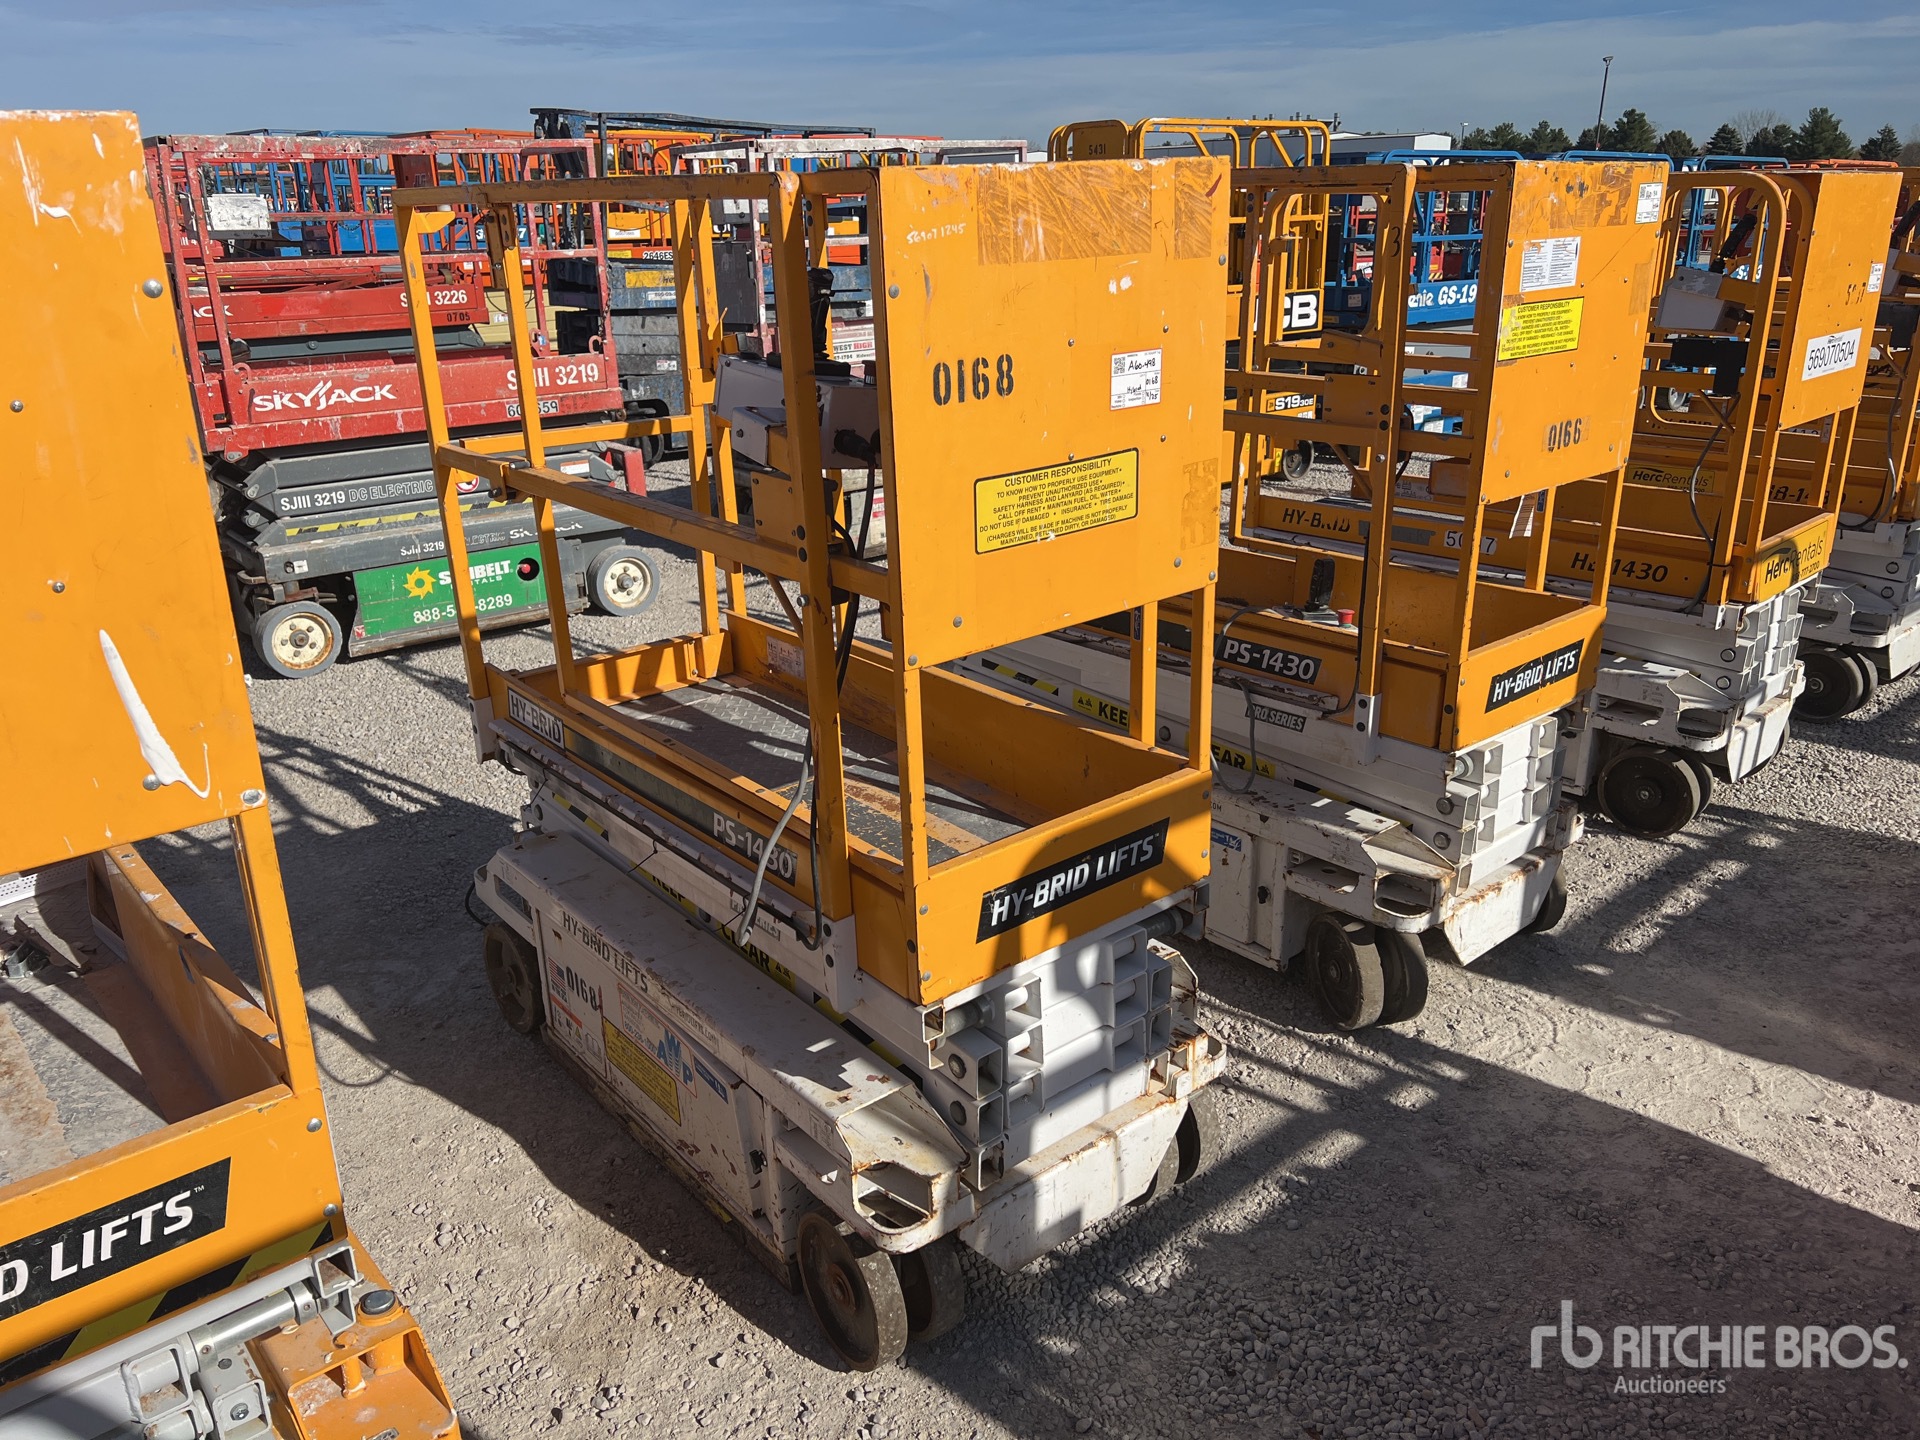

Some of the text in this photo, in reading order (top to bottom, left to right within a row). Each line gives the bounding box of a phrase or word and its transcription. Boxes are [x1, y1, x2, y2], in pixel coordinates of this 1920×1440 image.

[434, 289, 468, 306] 3226
[1407, 289, 1434, 308] enie
[447, 311, 471, 322] 0705
[555, 363, 599, 386] 3219
[933, 353, 1014, 406] 0168
[253, 379, 397, 412] SKYJACK
[1548, 418, 1582, 452] 0166
[997, 468, 1119, 499] TO KNOW HOW TO PROPERLY USE EQUIPMENT
[1005, 459, 1112, 487] CUSTOMER RESPONSIBILITY
[314, 490, 346, 507] 3219
[349, 487, 368, 503] DC
[369, 478, 433, 500] ELECTRIC
[993, 504, 1015, 514] SAFETY
[1017, 499, 1044, 509] HARNESS
[1045, 495, 1057, 503] AND
[1058, 489, 1083, 501] LANYARD
[998, 512, 1013, 521] CALL
[1014, 509, 1025, 517] OFF
[1027, 506, 1042, 515] RENT
[1047, 499, 1072, 510] MAINTAIN
[1100, 489, 1118, 498] WATER
[1019, 479, 1099, 502] PREVENT UNAUTHORIZED USE
[987, 531, 1016, 544] (CHARGES
[1016, 527, 1029, 536] WILL
[1061, 515, 1084, 526] MACHINE
[1091, 510, 1102, 518] NOT
[1102, 504, 1128, 515] PROPERLY
[989, 522, 1002, 531] NOT
[1002, 520, 1014, 528] USE
[1022, 512, 1049, 524] DAMAGED
[1061, 502, 1092, 515] INSURANCE
[1100, 497, 1111, 506] TIRE
[1112, 492, 1134, 503] DAMAGE
[423, 541, 445, 552] 3219
[438, 560, 511, 585] SBELT
[413, 593, 513, 624] 888-5-8289
[1223, 639, 1315, 680] PS-1430
[1493, 650, 1576, 702] HY-BRID LIFTS
[511, 694, 561, 743] HY-BRID
[1098, 701, 1128, 726] KEE
[1269, 709, 1304, 730] SERIES
[713, 811, 793, 879] PS-1430
[991, 836, 1153, 927] HY-BRID LIFTS
[566, 966, 599, 1011] 0168
[614, 952, 648, 994] LIFTS
[50, 1190, 193, 1282] LIFTS
